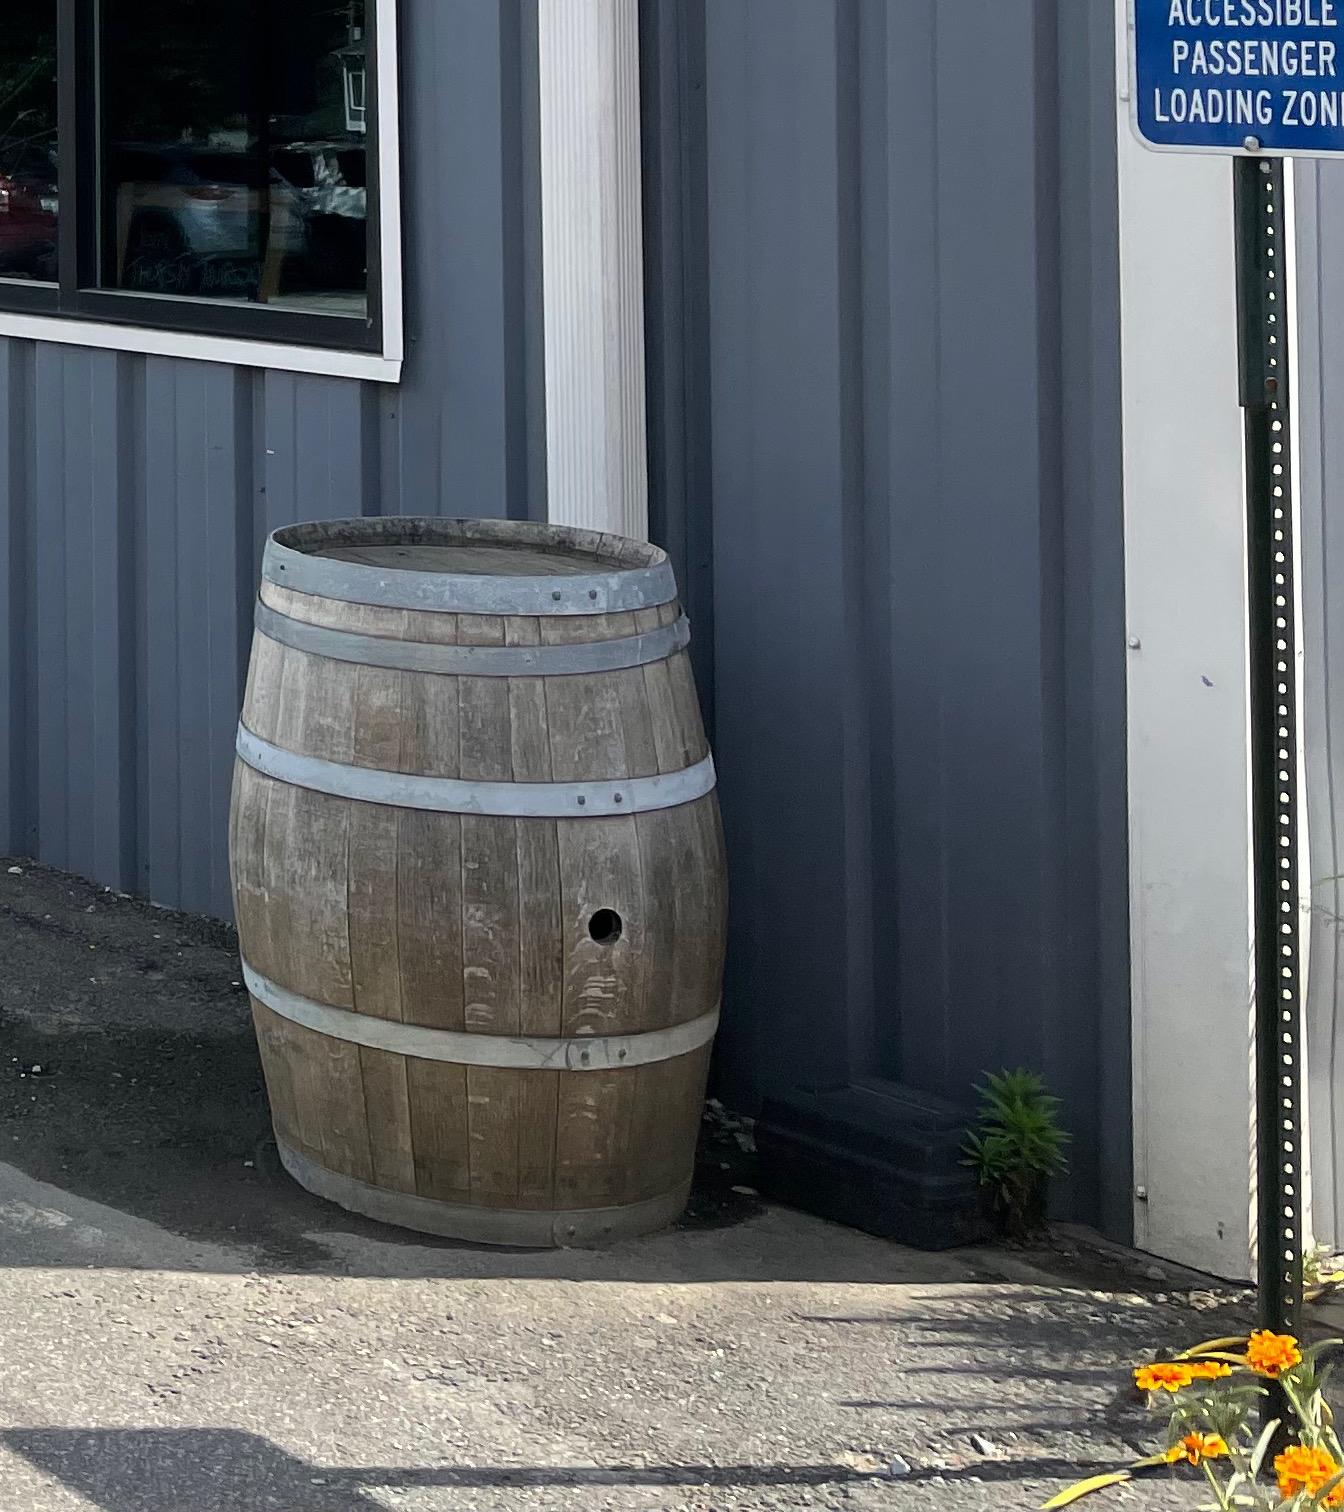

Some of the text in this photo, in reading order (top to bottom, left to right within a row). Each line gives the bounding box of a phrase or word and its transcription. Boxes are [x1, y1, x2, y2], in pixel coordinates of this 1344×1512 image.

[1173, 40, 1336, 77] PASSENGER
[1154, 88, 1344, 127] LOADING ZON
